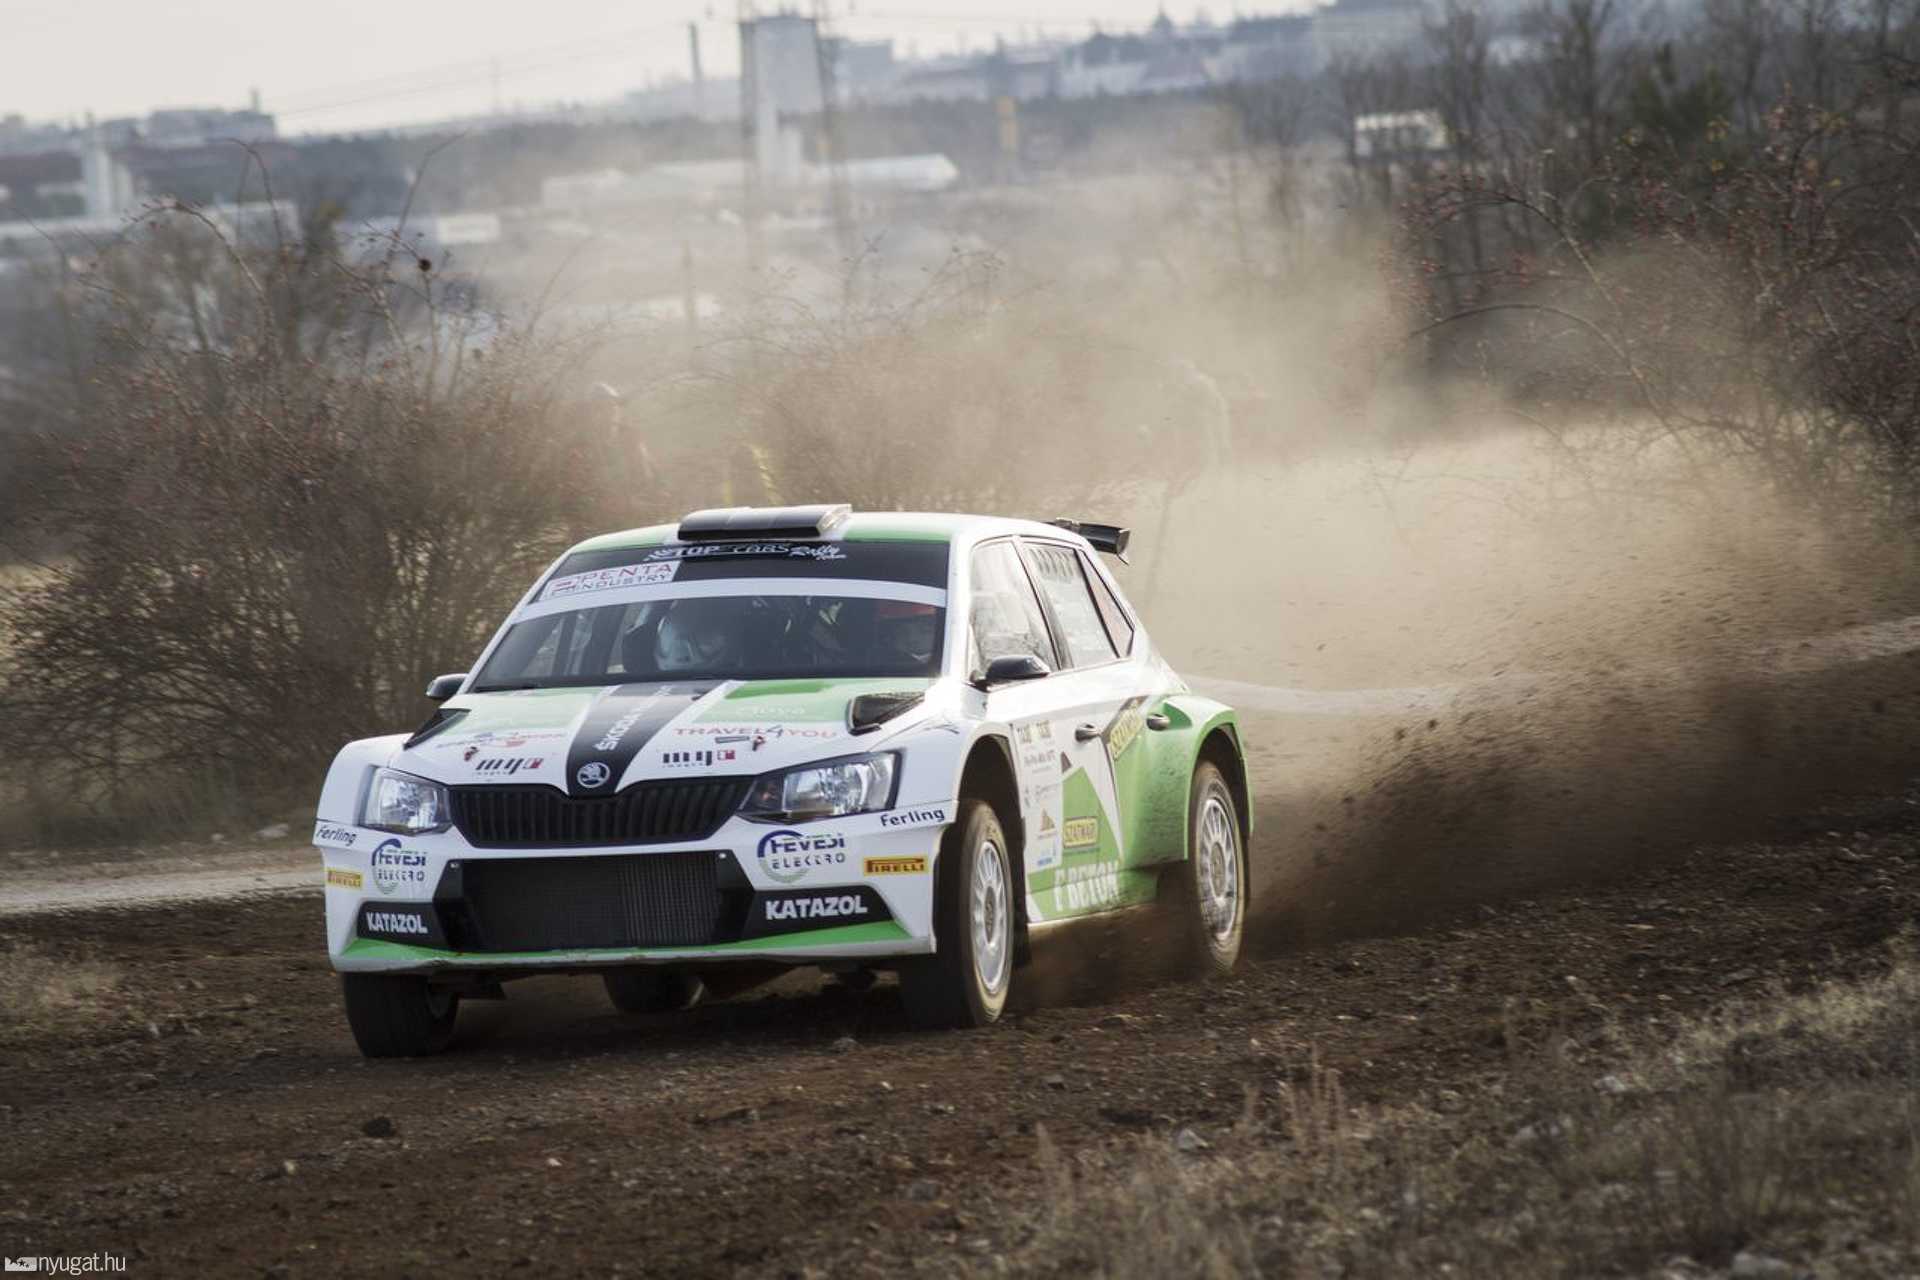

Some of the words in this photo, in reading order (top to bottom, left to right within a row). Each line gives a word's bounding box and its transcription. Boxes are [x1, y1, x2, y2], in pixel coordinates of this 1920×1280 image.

[672, 545, 720, 558] TOP
[577, 562, 673, 582] PENTA
[674, 724, 838, 740] TRAVEL4YOU
[880, 807, 945, 827] Ferling
[316, 825, 357, 847] Ferling
[866, 857, 925, 873] PIRELLI
[766, 895, 868, 920] KATAZOL
[366, 912, 429, 934] KATAZOL
